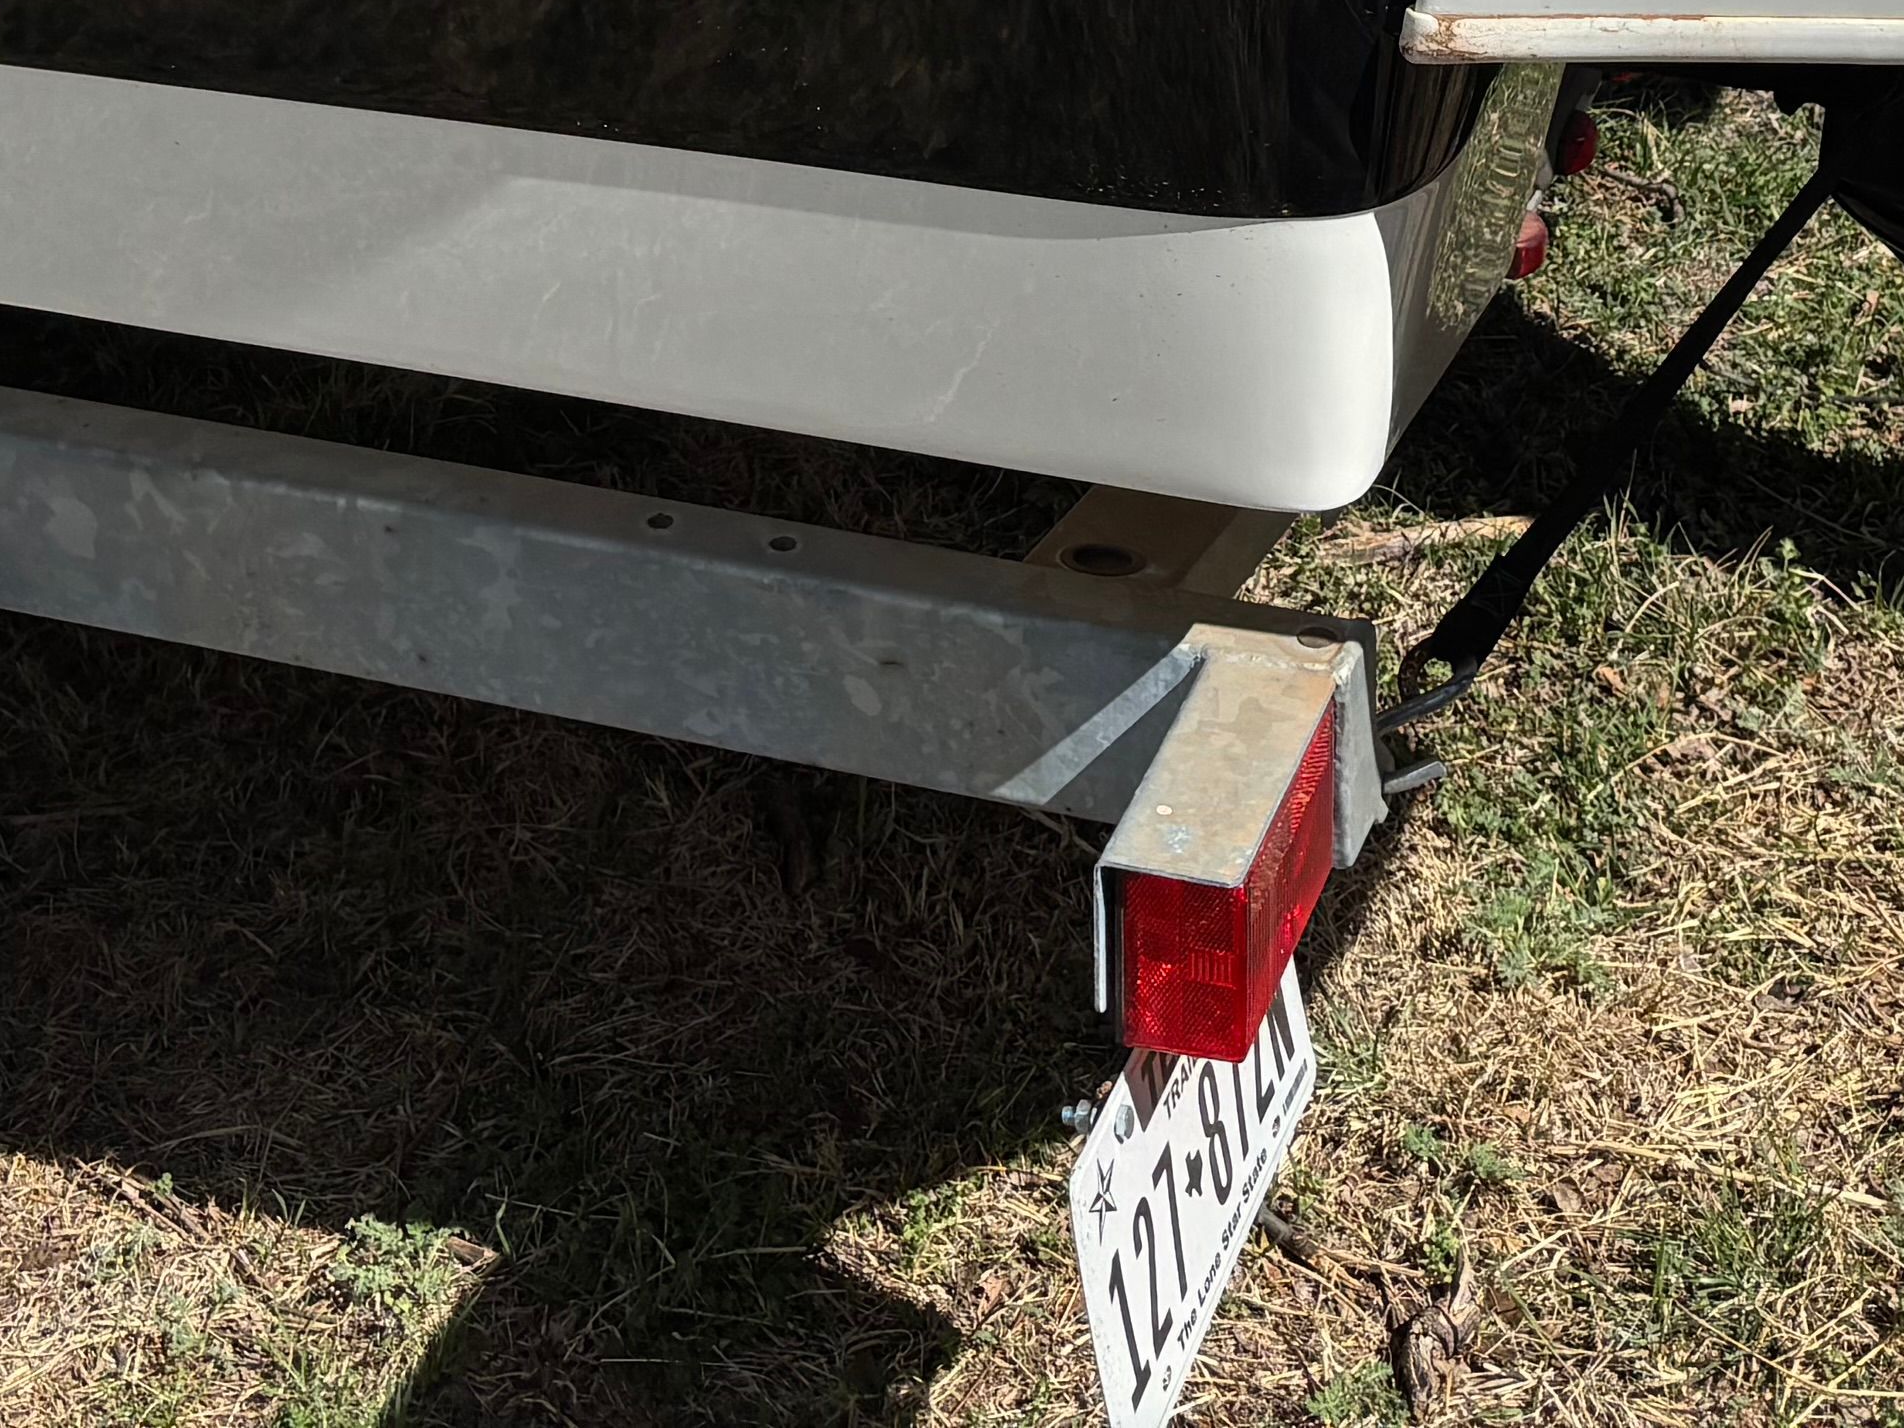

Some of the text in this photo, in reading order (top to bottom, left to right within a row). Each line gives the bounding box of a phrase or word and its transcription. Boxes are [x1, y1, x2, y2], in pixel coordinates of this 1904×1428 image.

[1109, 1141, 1188, 1413] 127
[1177, 1148, 1268, 1351] The Lone Star State
